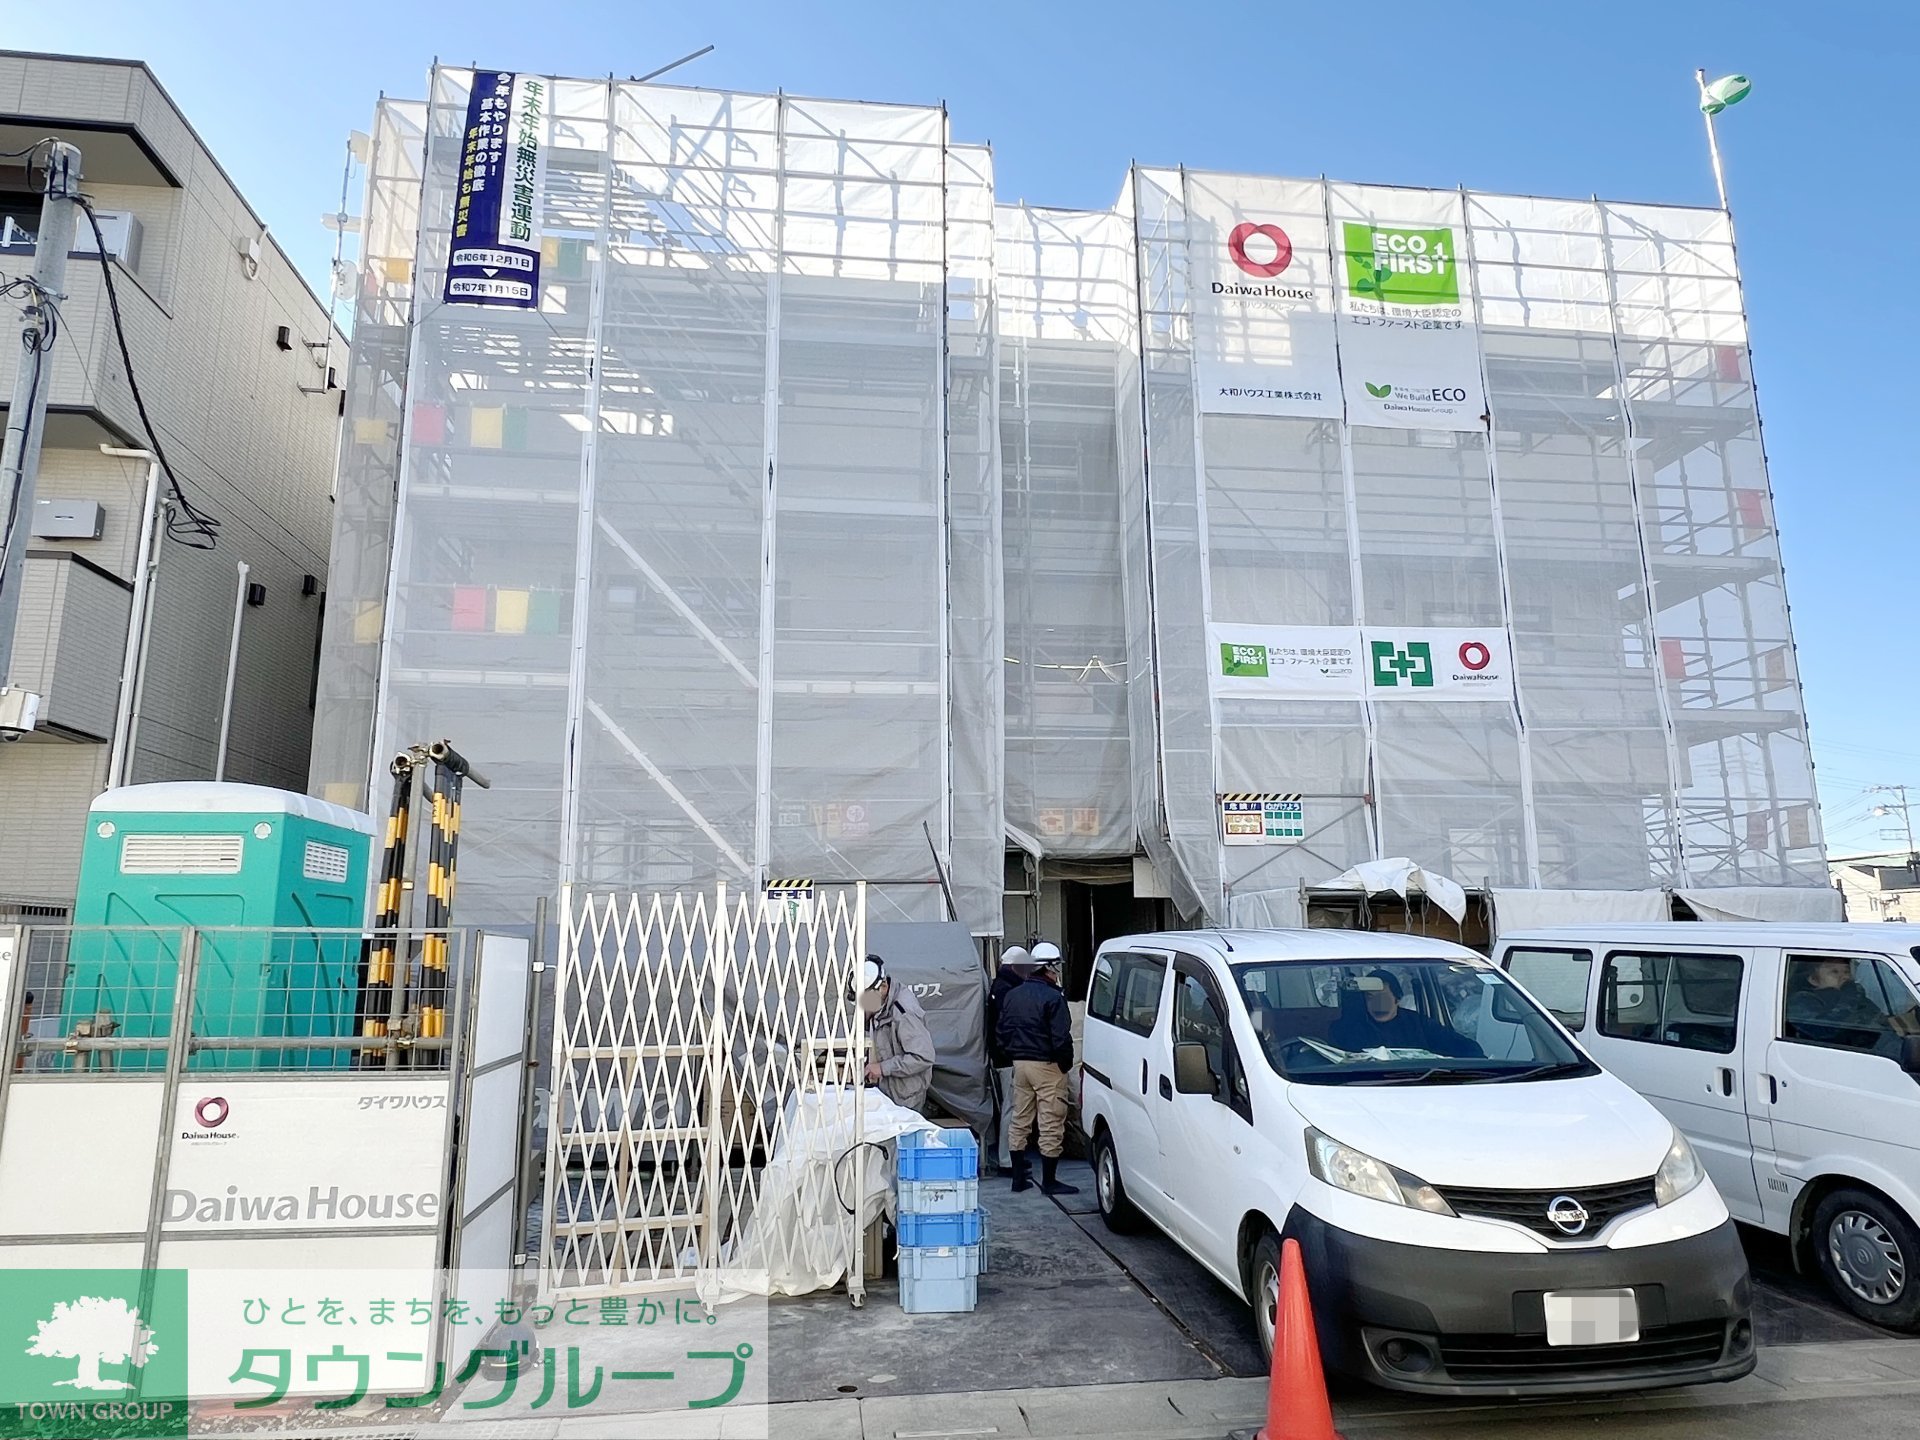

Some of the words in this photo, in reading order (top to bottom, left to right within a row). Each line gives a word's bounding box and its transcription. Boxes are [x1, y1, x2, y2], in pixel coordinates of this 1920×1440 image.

[509, 80, 543, 242] 年末年始無災害運動
[1373, 232, 1427, 254] ECO
[456, 252, 530, 268] 令和6年12月1日
[1374, 246, 1449, 275] FIRST
[452, 283, 528, 297] 令和7年1月15日
[1211, 281, 1262, 296] Daiwa
[1264, 285, 1313, 300] House
[1219, 388, 1322, 401] 大和ハウス工業株式会社
[1394, 392, 1409, 400] We
[1409, 393, 1431, 401] Build
[1432, 388, 1466, 402] ECO
[1232, 646, 1256, 655] ECO
[1233, 653, 1264, 665] FIRST
[357, 1096, 447, 1110] ダイワハウス
[162, 1185, 300, 1223] Daiwa
[306, 1186, 439, 1219] House
